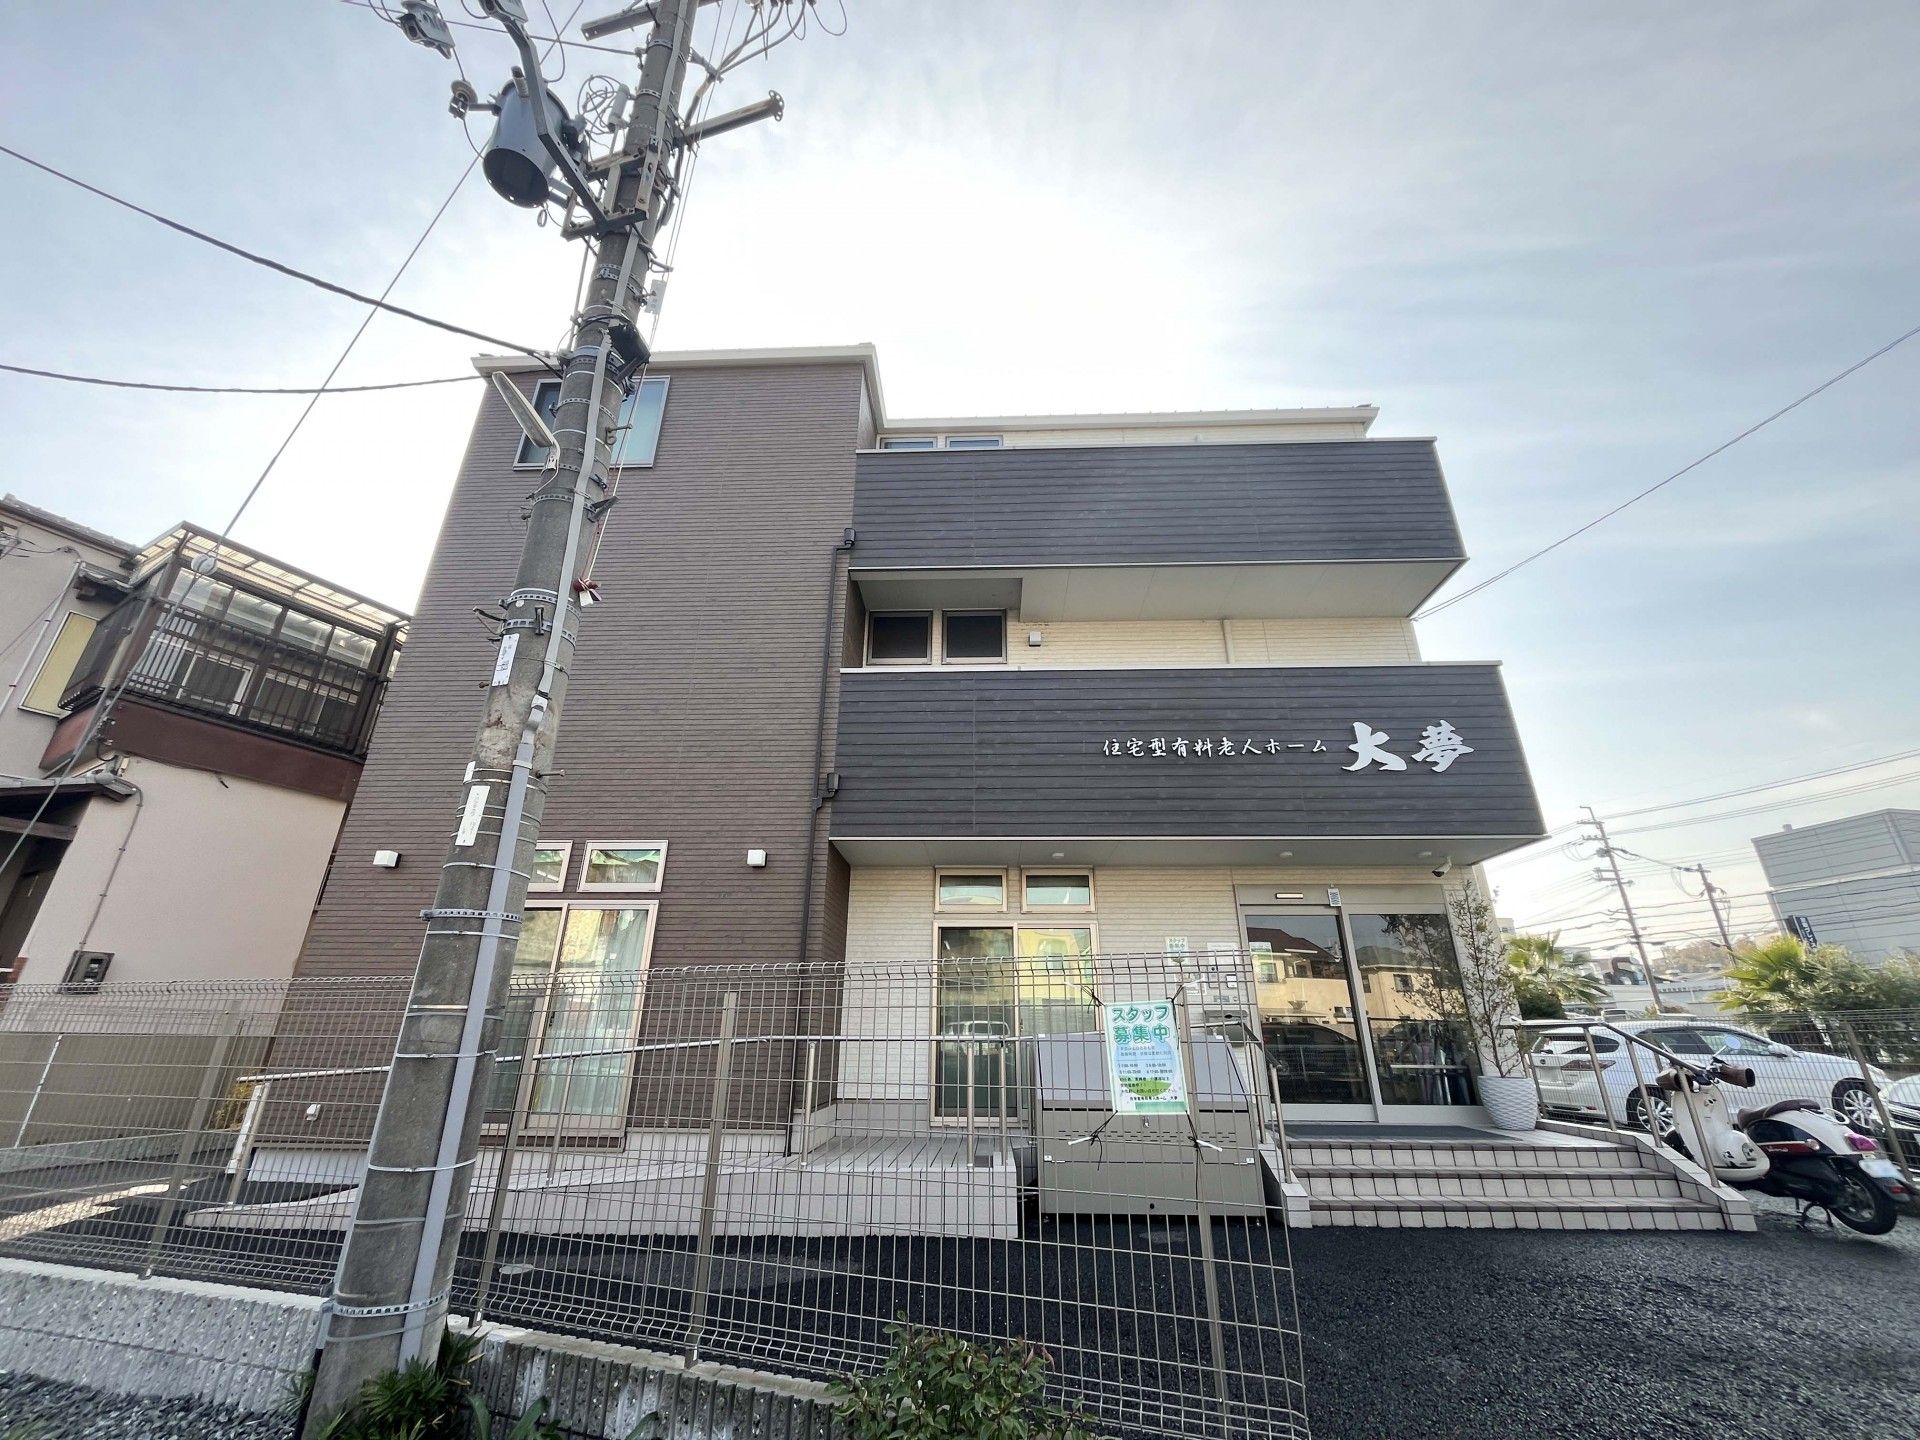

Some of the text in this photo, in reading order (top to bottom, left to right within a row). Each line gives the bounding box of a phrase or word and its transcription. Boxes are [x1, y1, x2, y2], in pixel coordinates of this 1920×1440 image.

[1102, 719, 1475, 773] 住宅型有料老人ホーム 大夢
[1112, 1005, 1169, 1023] スタッフ
[1113, 1023, 1171, 1044] 募集中
